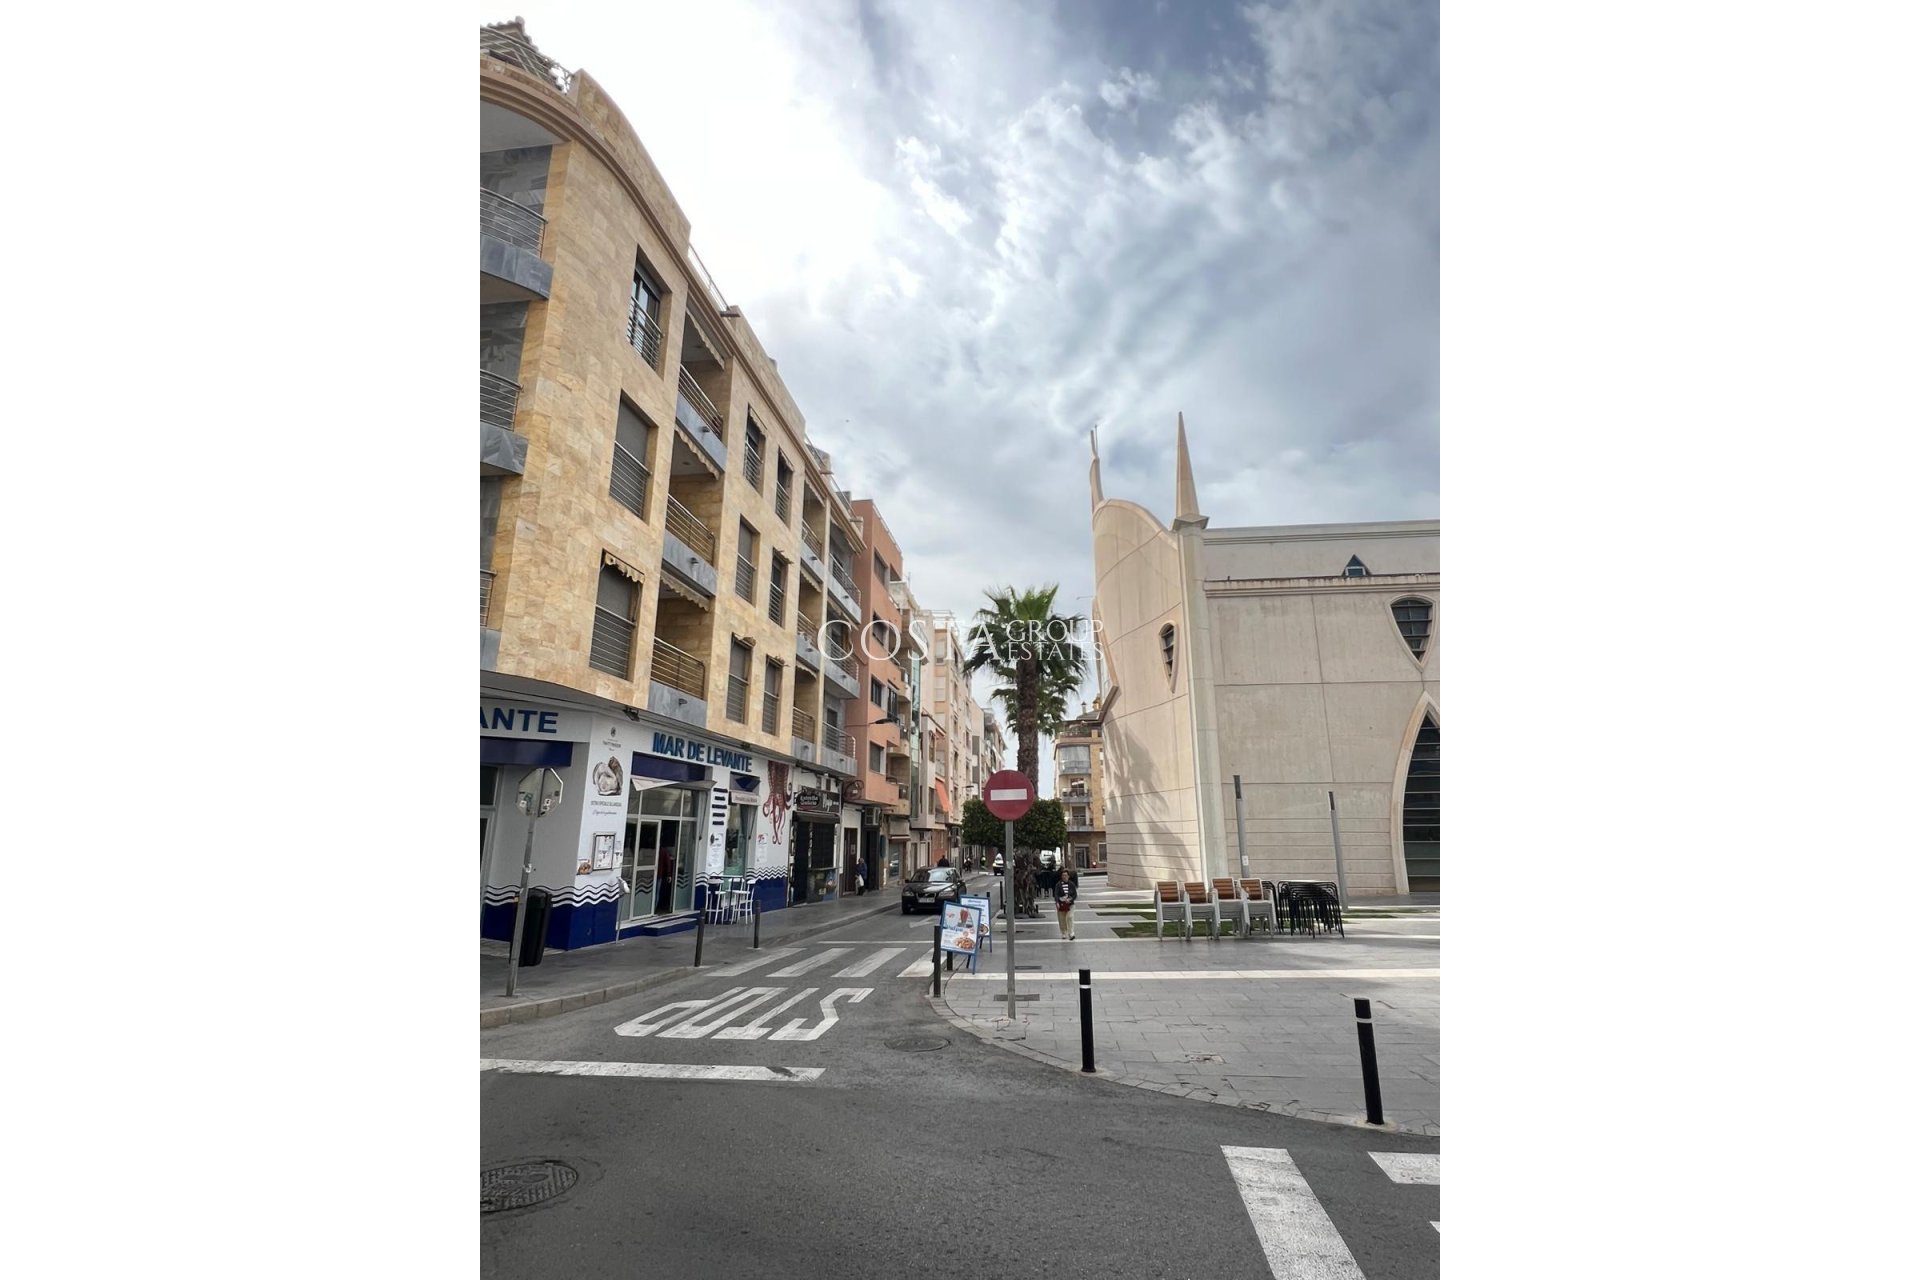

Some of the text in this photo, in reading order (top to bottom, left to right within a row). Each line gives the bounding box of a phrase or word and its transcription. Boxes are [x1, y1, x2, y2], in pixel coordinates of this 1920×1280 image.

[652, 731, 752, 772] MAR DE LEVANTE
[613, 986, 875, 1041] STOP
